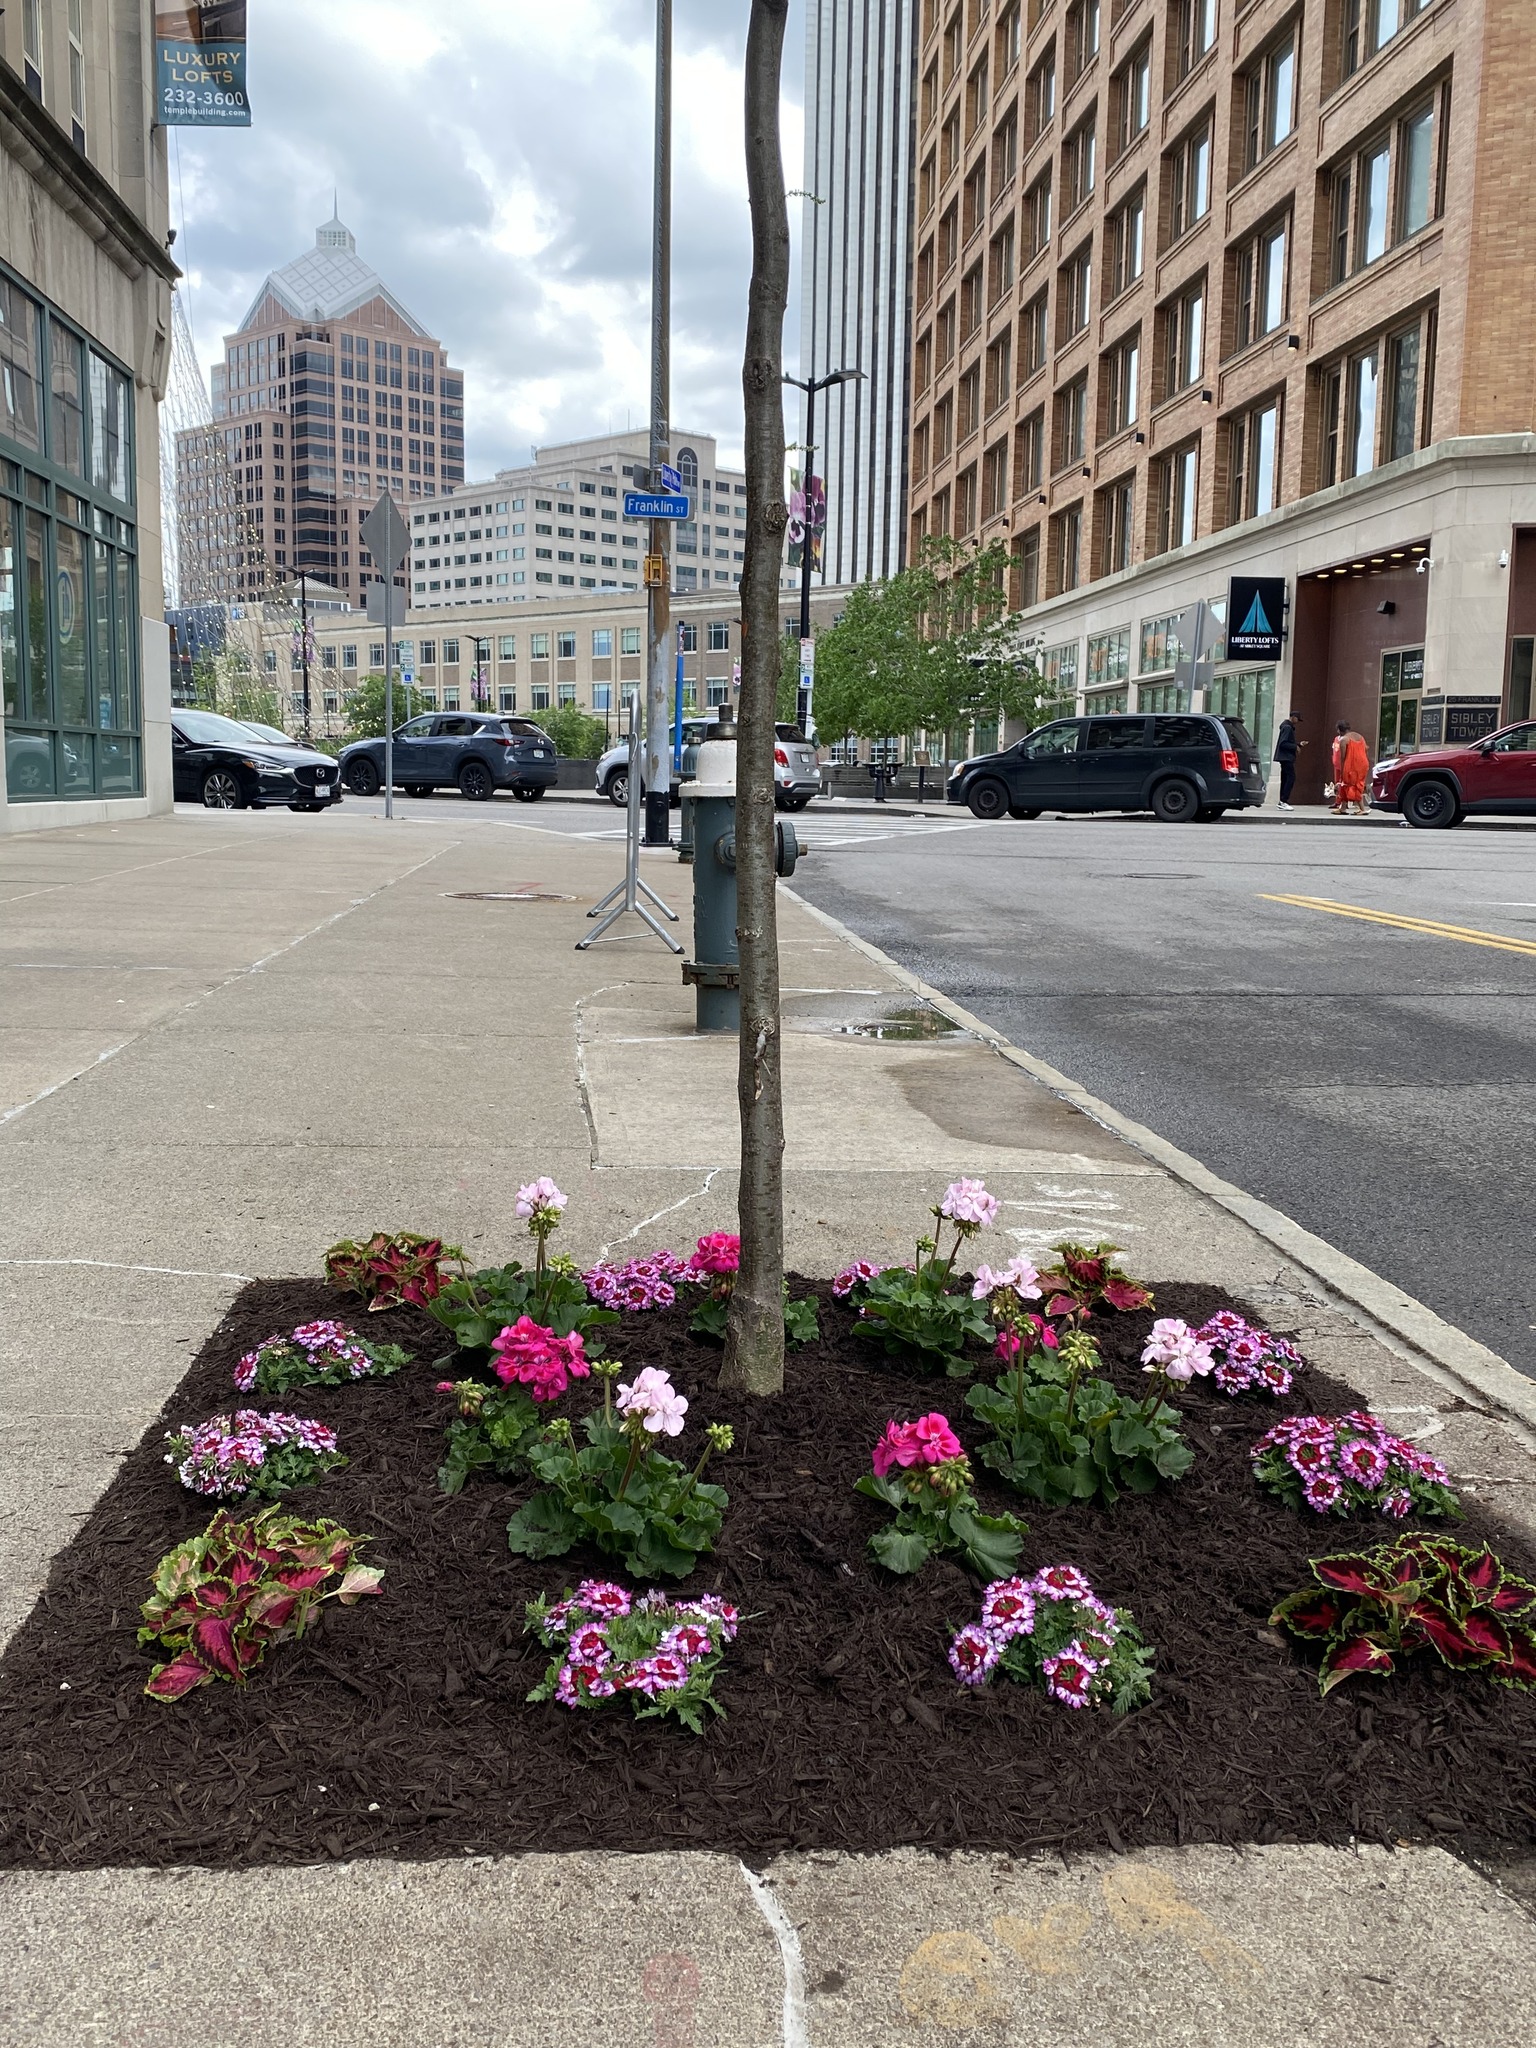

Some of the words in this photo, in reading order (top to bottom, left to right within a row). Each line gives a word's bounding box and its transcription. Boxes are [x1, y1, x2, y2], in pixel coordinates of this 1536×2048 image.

[163, 49, 241, 67] LUXURY
[172, 68, 233, 84] LOFTS
[164, 87, 244, 106] 232-3600
[164, 105, 246, 117] templebuilding.com
[628, 498, 673, 513] Franklin
[675, 505, 685, 514] ST
[1451, 713, 1495, 724] SIBLEY
[1423, 726, 1440, 738] TOWER
[1450, 727, 1493, 737] TOWER
